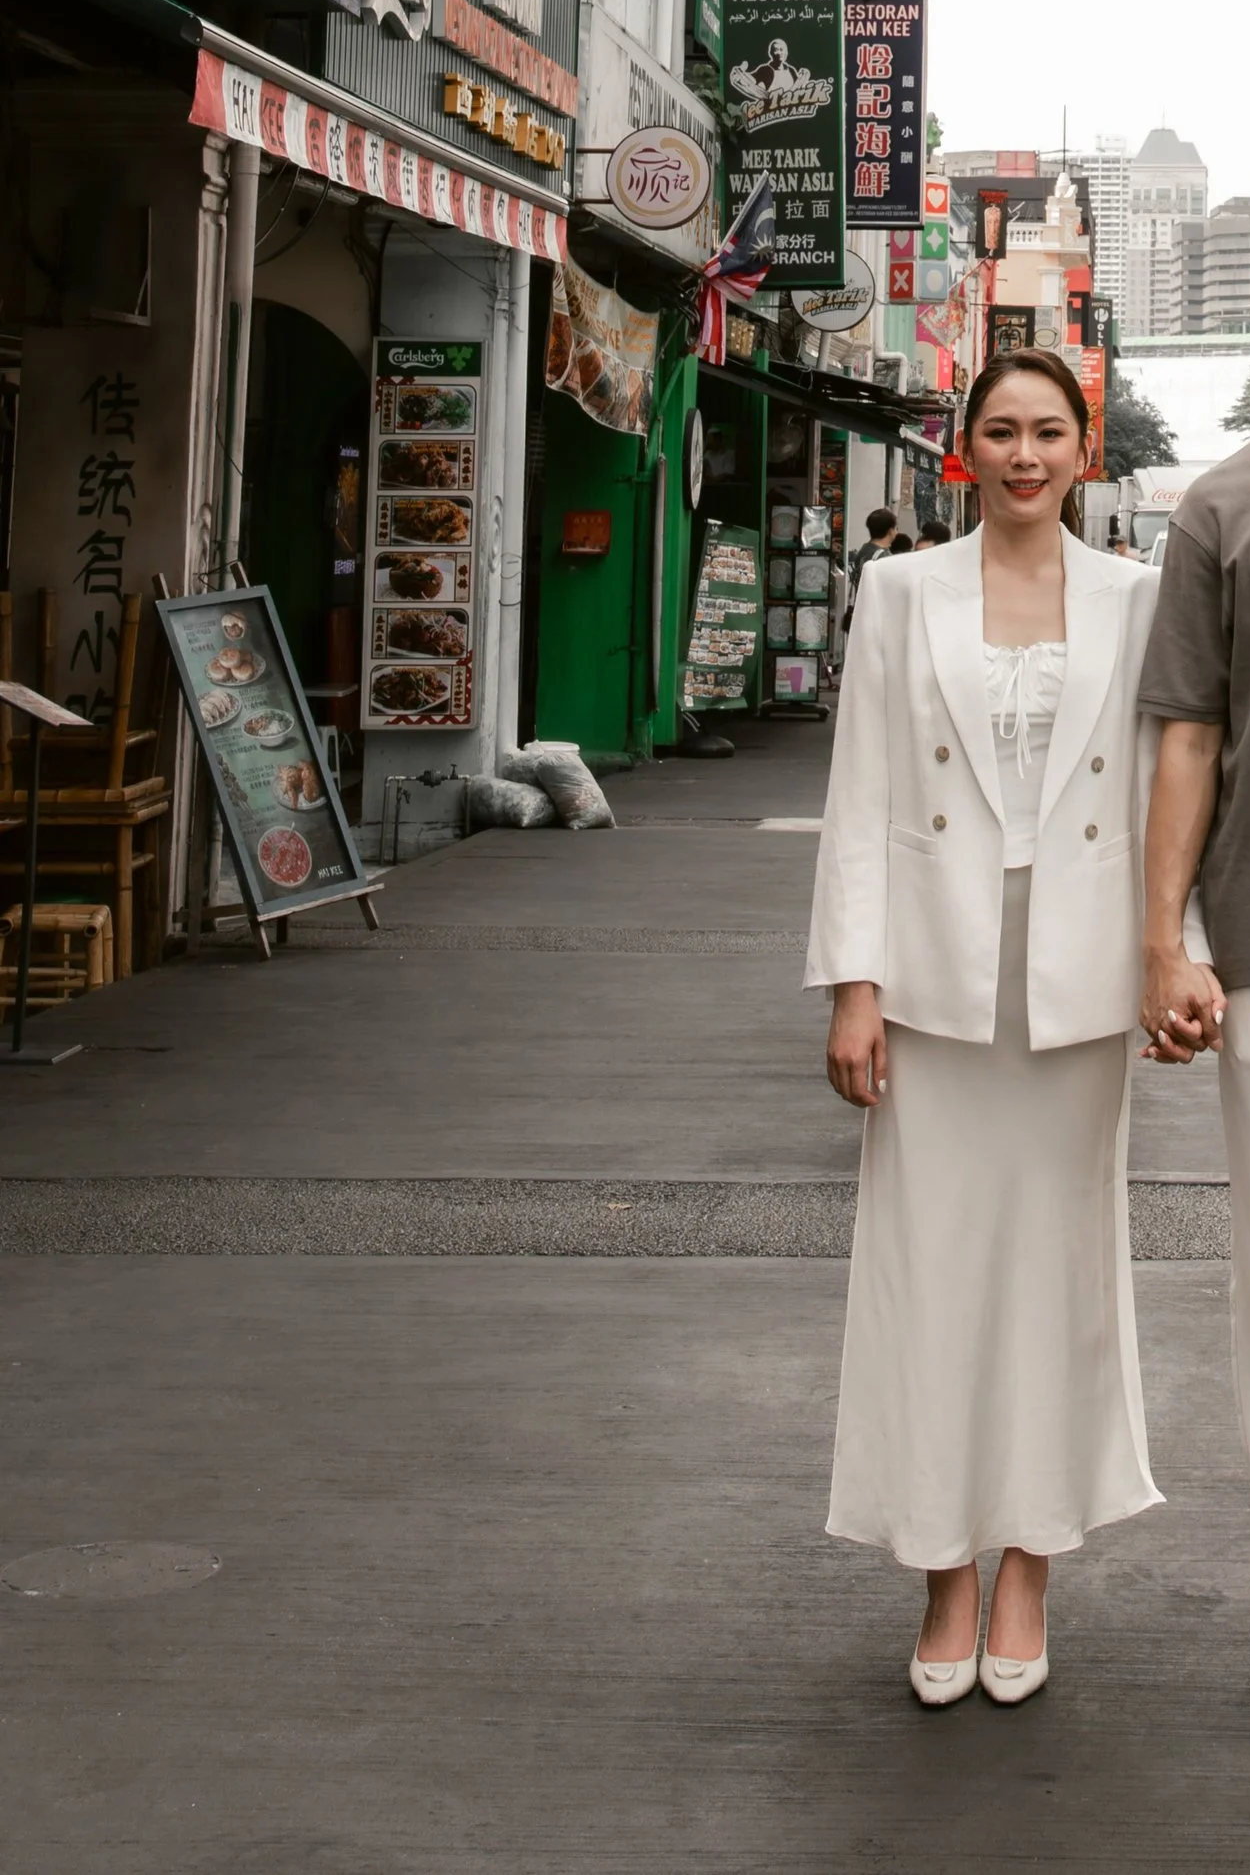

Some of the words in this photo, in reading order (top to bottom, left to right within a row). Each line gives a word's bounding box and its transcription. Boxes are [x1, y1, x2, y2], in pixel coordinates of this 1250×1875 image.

[882, 21, 911, 37] KEE
[768, 81, 833, 110] Tarik
[231, 78, 256, 137] HAI
[742, 149, 772, 169] MEE
[774, 148, 821, 168] TARIK
[801, 172, 835, 192] ASLI
[388, 347, 445, 367] Carlsberg
